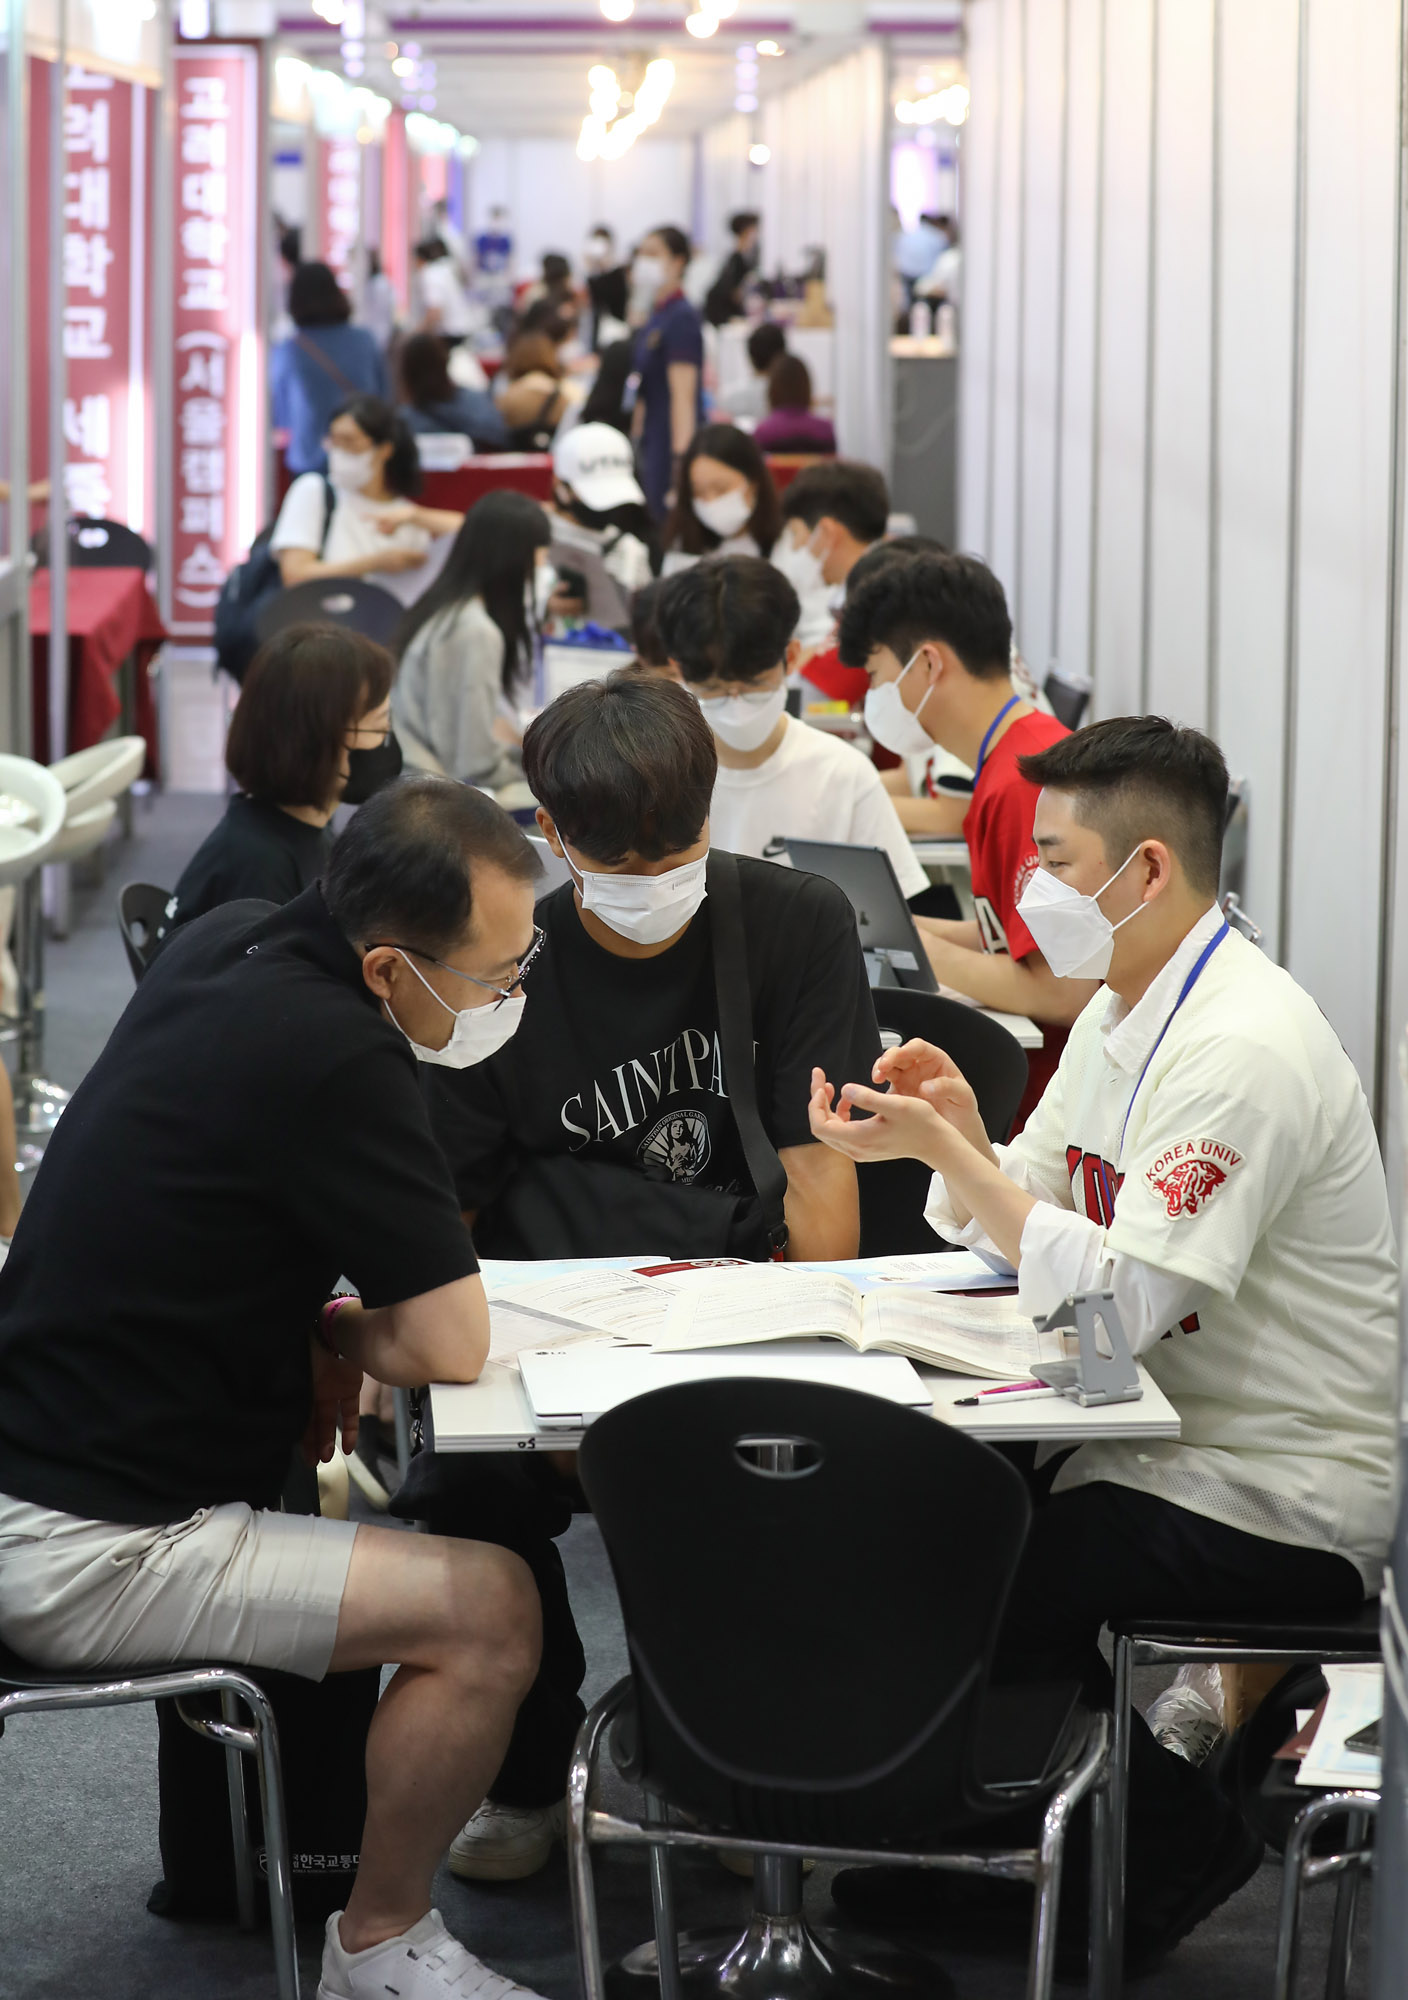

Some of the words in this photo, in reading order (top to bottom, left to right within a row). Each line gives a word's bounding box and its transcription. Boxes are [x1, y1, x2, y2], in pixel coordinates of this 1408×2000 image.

[180, 76, 230, 311] 고려대학교
[1146, 1142, 1195, 1181] KOREA
[1200, 1141, 1241, 1167] UNIV
